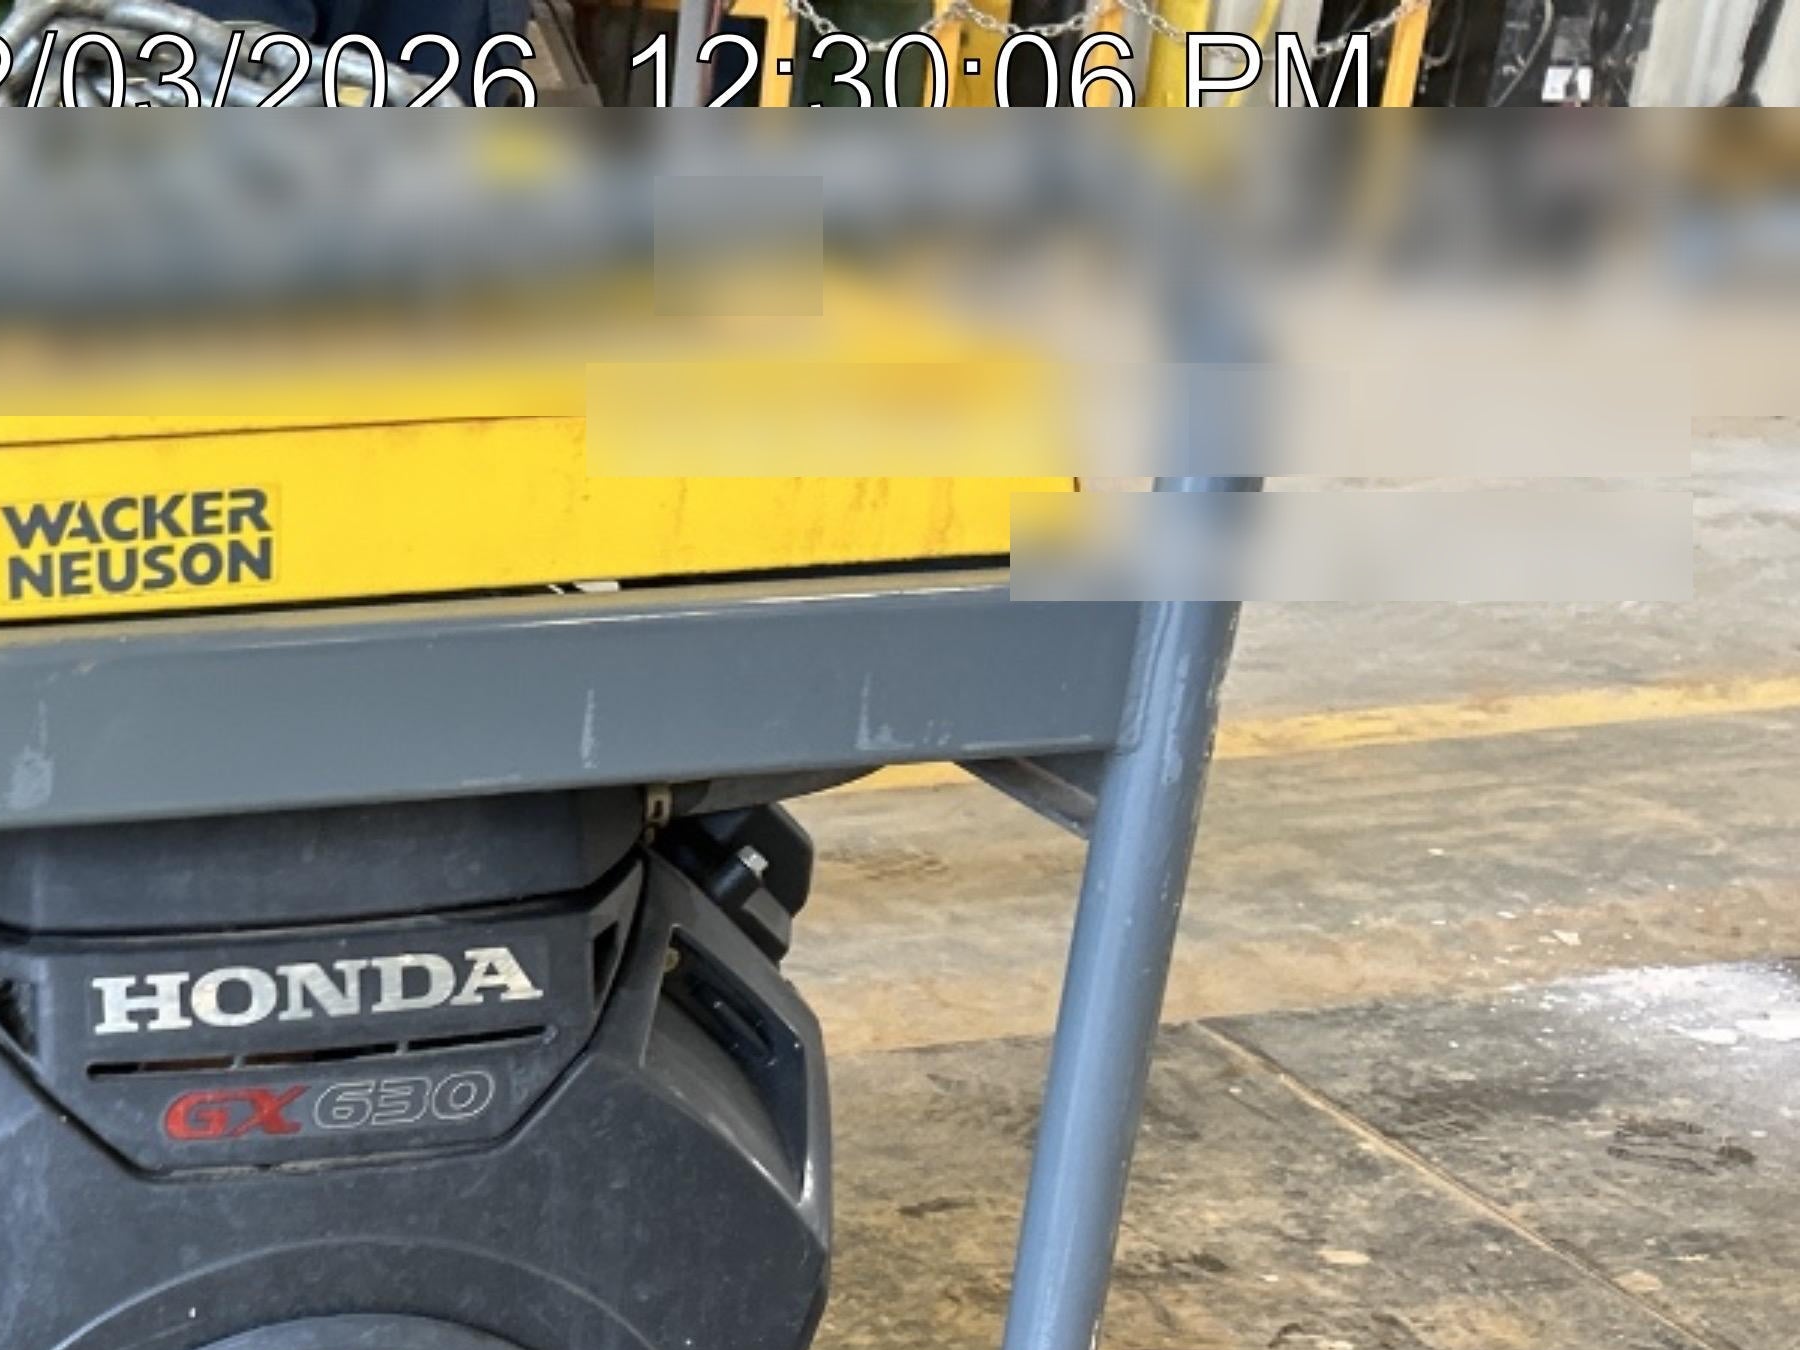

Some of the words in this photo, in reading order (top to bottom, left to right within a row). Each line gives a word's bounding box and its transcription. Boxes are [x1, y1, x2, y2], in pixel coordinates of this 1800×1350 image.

[1, 487, 272, 550] WACKER
[8, 537, 274, 601] NEUSON
[92, 946, 543, 1034] HONDA
